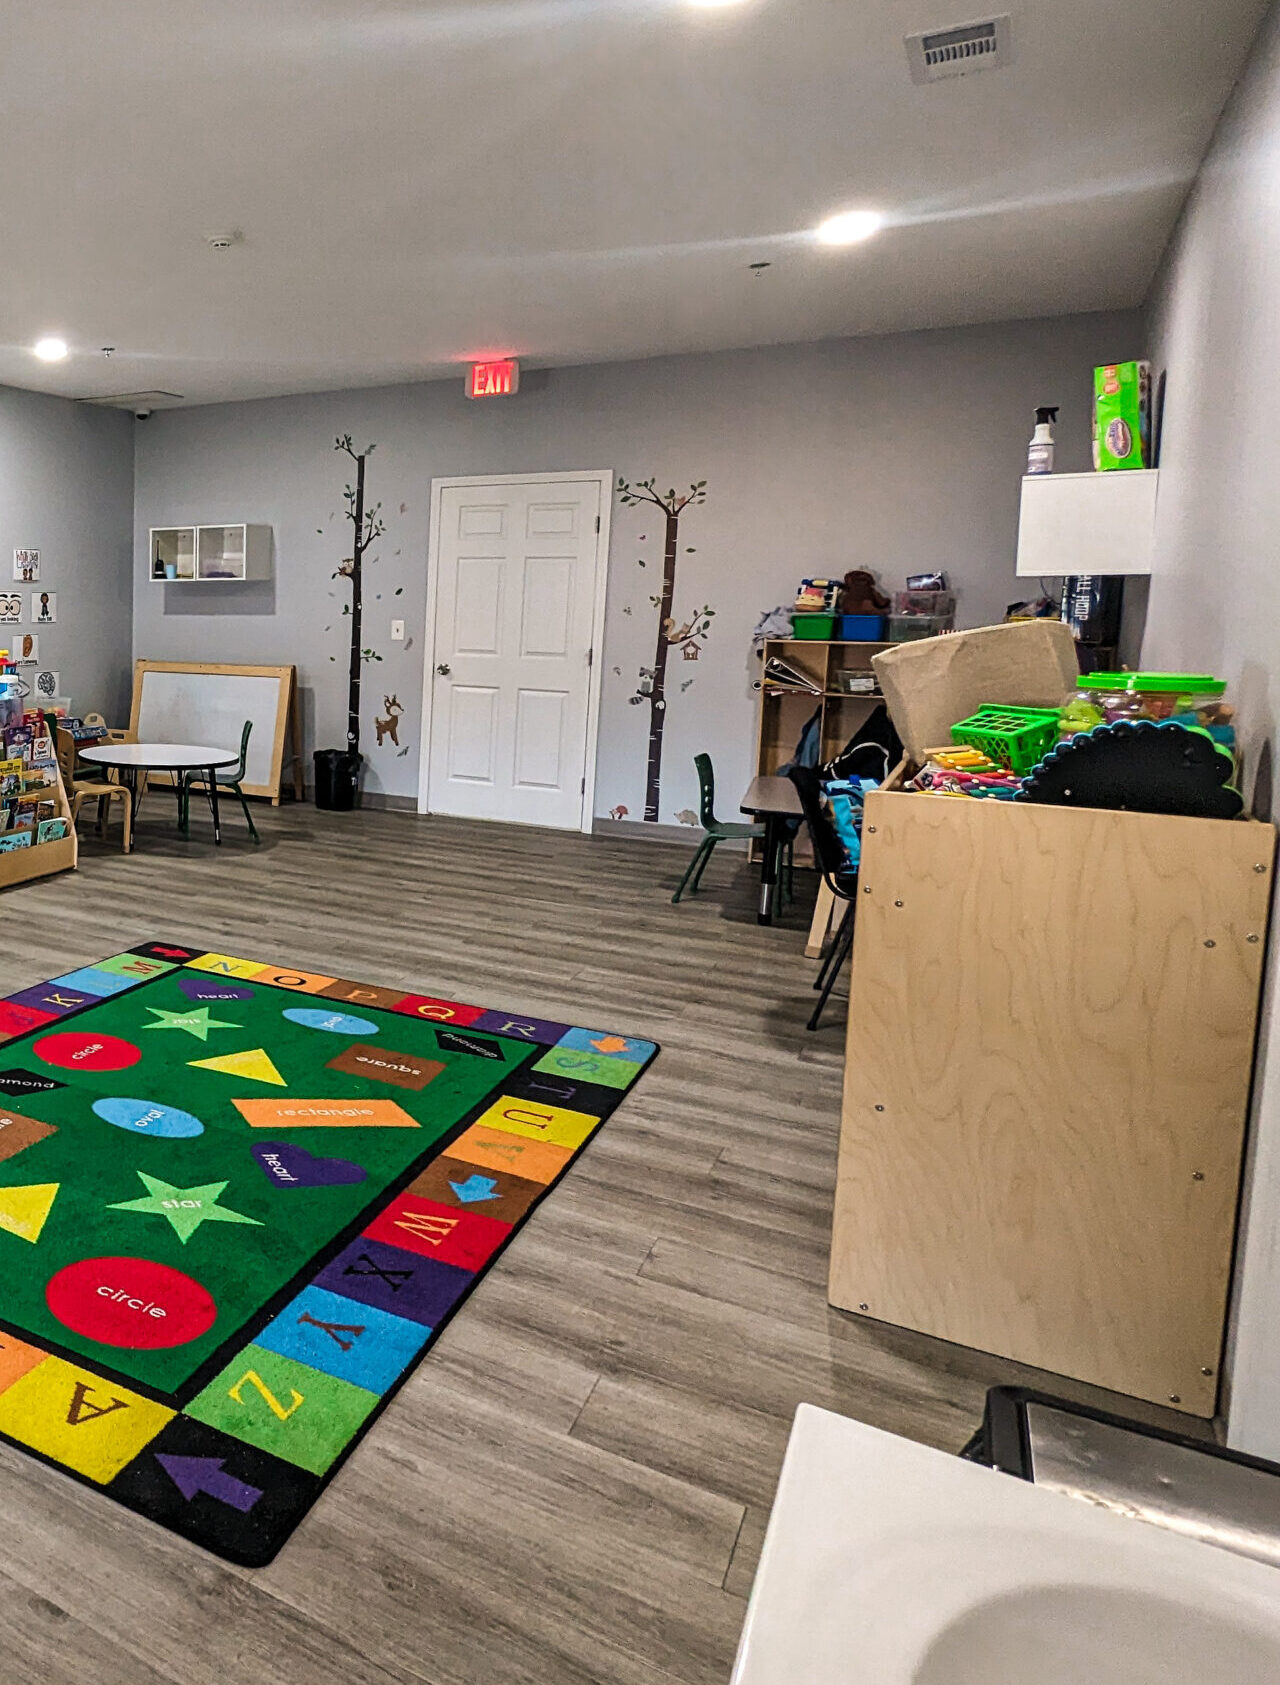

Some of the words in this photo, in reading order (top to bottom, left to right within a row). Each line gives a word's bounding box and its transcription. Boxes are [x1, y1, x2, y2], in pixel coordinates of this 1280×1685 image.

[473, 362, 514, 395] EXIT
[1074, 595, 1090, 621] HOOP
[122, 960, 162, 975] M
[209, 960, 242, 973] N
[273, 975, 306, 987] O
[41, 993, 84, 1008] K
[344, 989, 379, 1001] P
[418, 1005, 455, 1020] Q
[498, 1020, 537, 1038] R
[72, 1043, 103, 1060] circle
[441, 1033, 498, 1058] diamond
[355, 1056, 422, 1076] square
[555, 1056, 599, 1074] S
[134, 1108, 167, 1128] oval
[276, 1106, 374, 1117] rectangle
[502, 1108, 554, 1130] U
[261, 1153, 298, 1183] heart
[161, 1197, 202, 1210] star
[393, 1211, 460, 1247] W
[342, 1253, 415, 1293] X
[96, 1286, 167, 1319] circle
[296, 1311, 367, 1353] Y
[65, 1381, 131, 1426] A
[228, 1369, 305, 1422] Z
